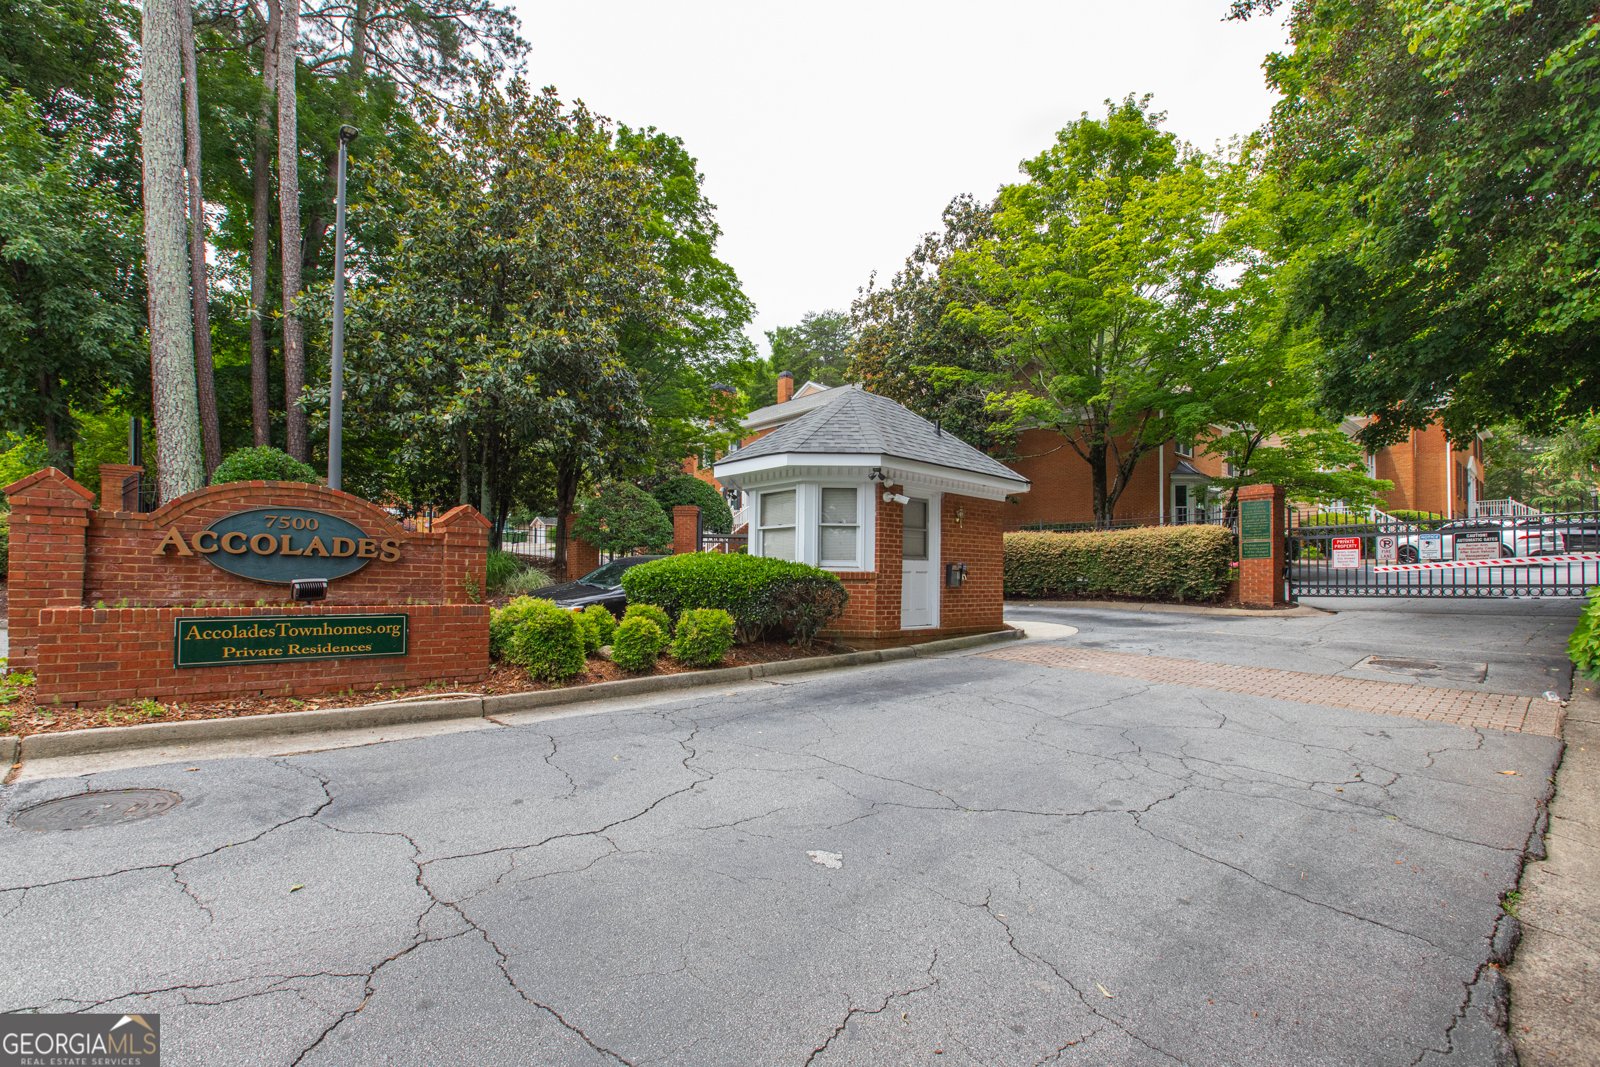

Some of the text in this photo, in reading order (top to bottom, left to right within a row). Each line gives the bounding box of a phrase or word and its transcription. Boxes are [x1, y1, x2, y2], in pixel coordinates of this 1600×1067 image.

[264, 515, 319, 531] 7500
[152, 526, 402, 563] ACCOLADES
[184, 622, 402, 641] AccoladesTownhomes.org
[222, 642, 373, 659] Private Residences
